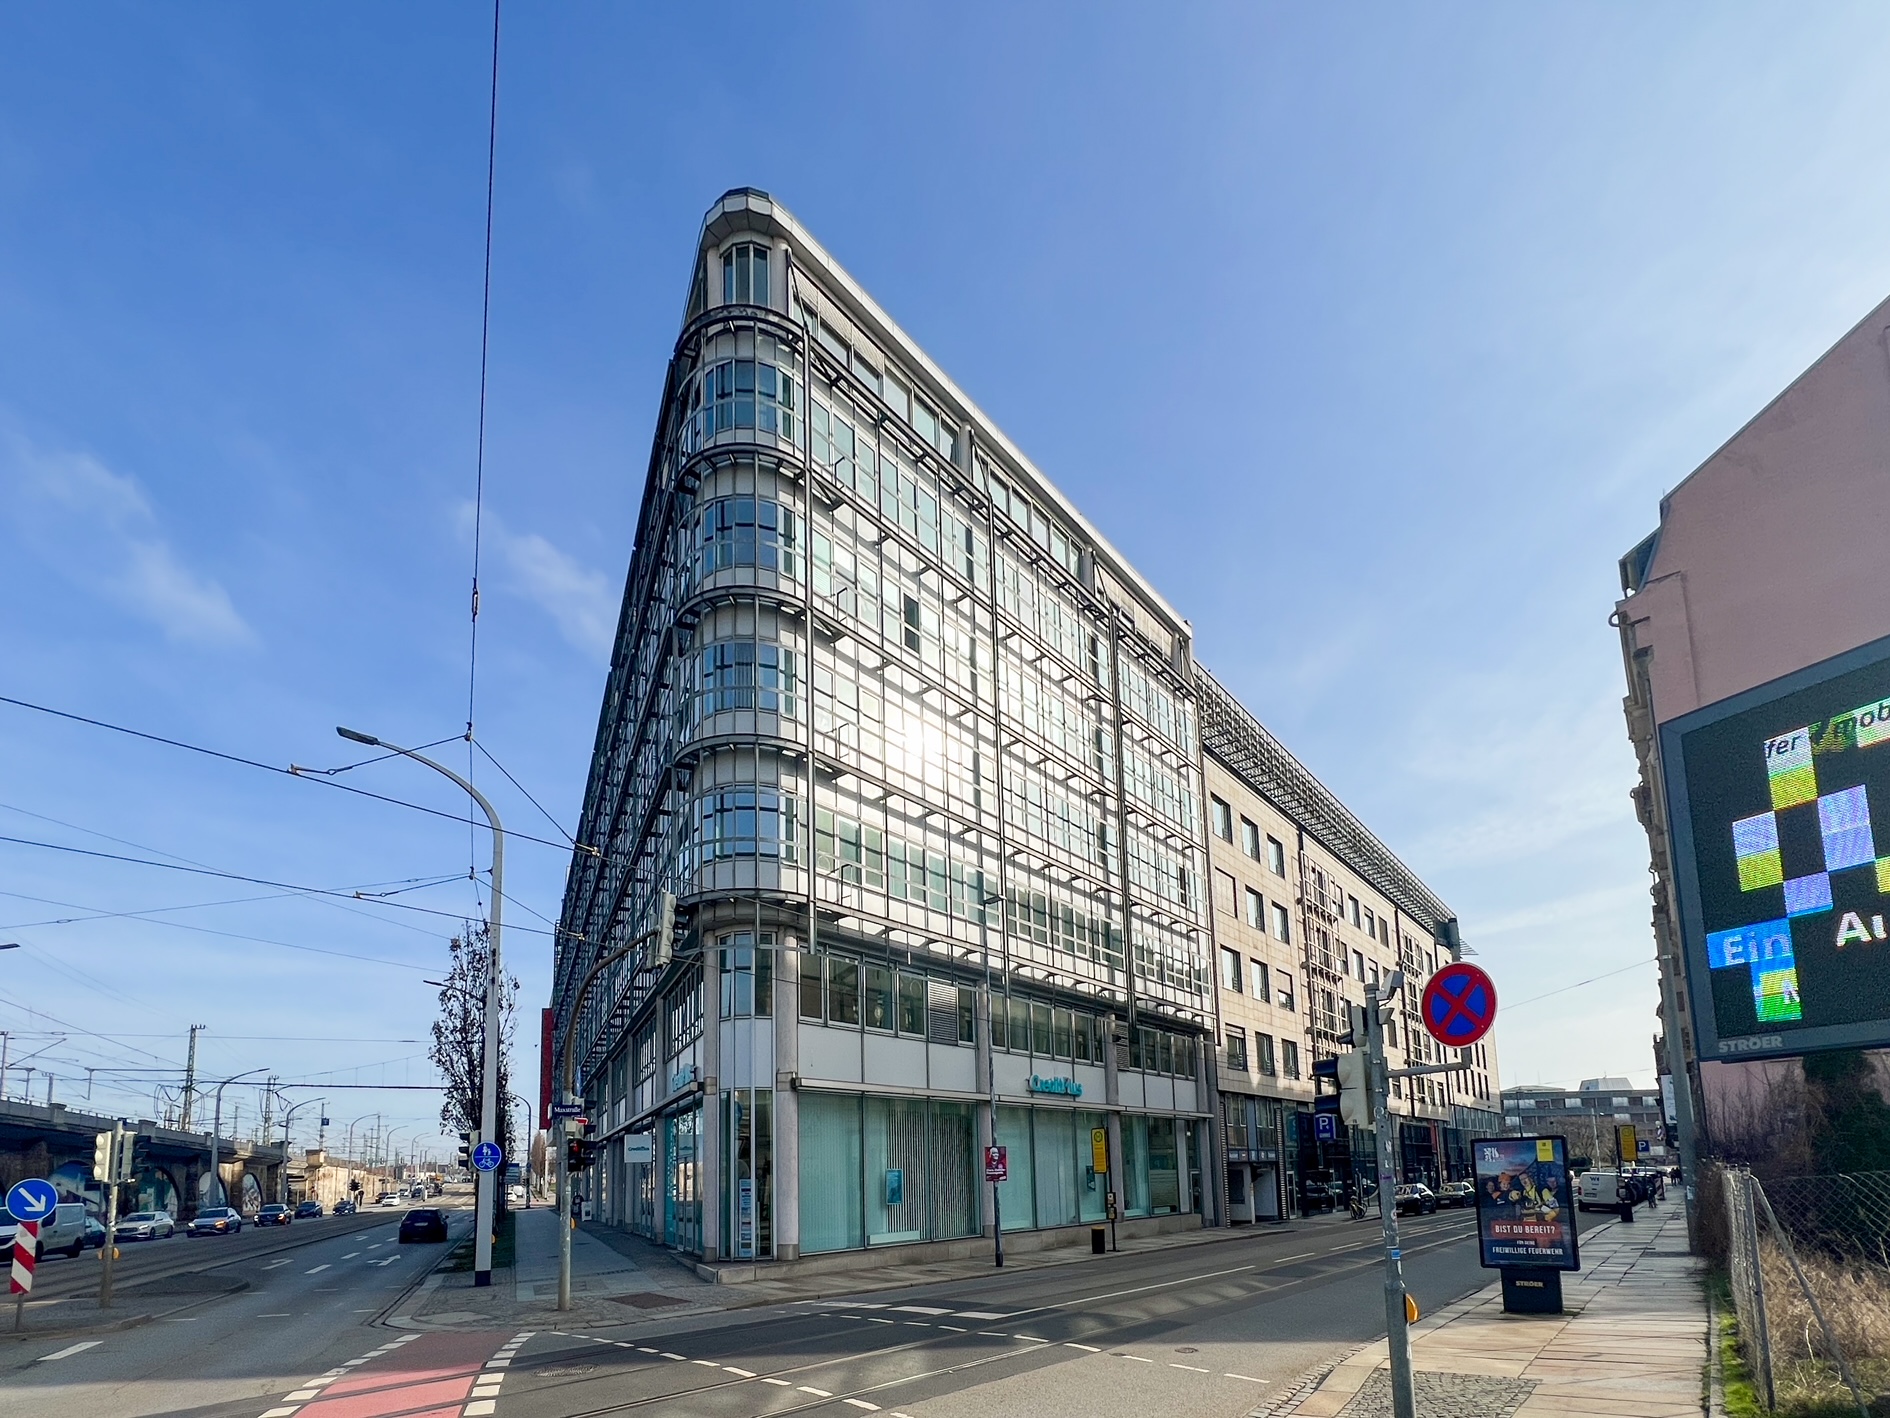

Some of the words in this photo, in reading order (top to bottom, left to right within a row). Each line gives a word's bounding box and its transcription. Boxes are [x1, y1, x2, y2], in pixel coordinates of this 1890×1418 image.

[1723, 932, 1793, 966] Ein
[1718, 1034, 1783, 1054] STRÖER
[1638, 1141, 1646, 1151] P
[1495, 1225, 1511, 1233] BIST
[1513, 1225, 1523, 1234] DU
[1525, 1225, 1556, 1235] BEREIT?
[1492, 1246, 1527, 1255] FREIWILLIGE
[1528, 1247, 1564, 1256] FEUERWEHR
